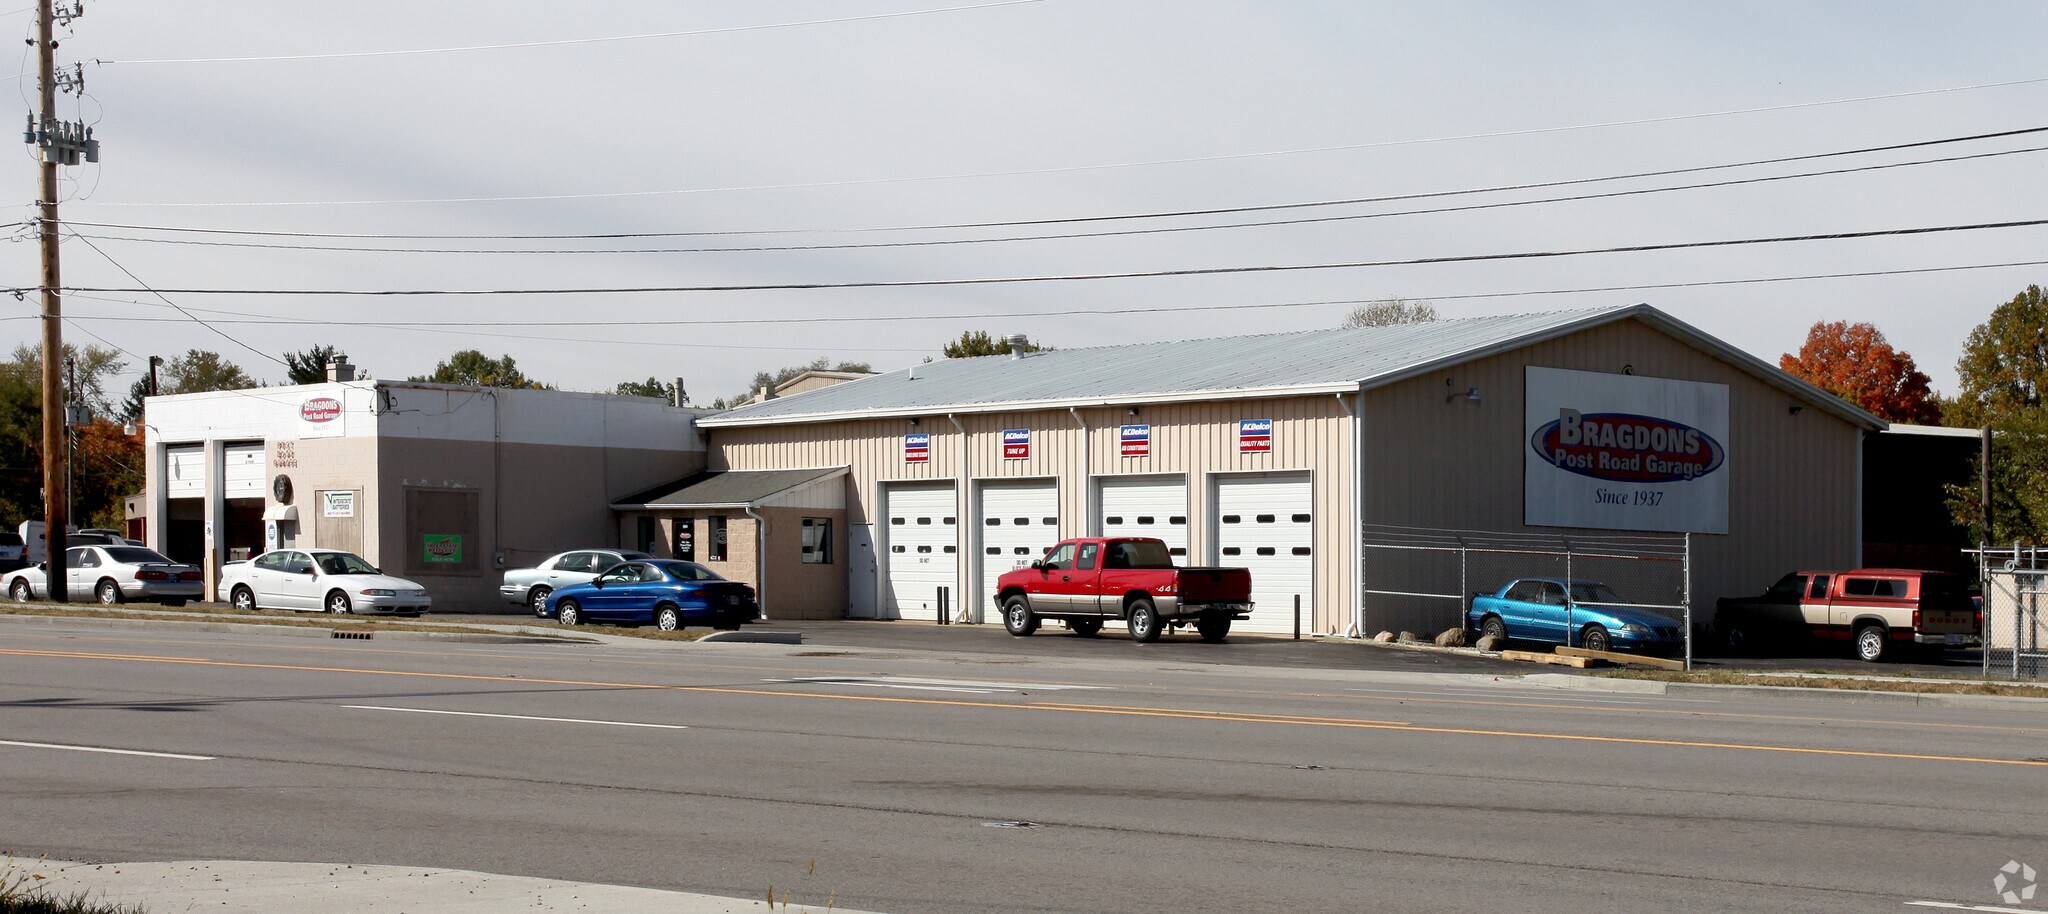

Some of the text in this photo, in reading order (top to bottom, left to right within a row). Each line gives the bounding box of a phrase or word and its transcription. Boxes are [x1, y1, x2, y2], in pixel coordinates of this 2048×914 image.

[304, 399, 337, 411] BRAGDONS
[1005, 432, 1029, 440] ACDelco
[1560, 408, 1700, 454] BRAGDONS
[1555, 449, 1703, 479] Post Road Garage
[1595, 488, 1664, 506] Since 1937
